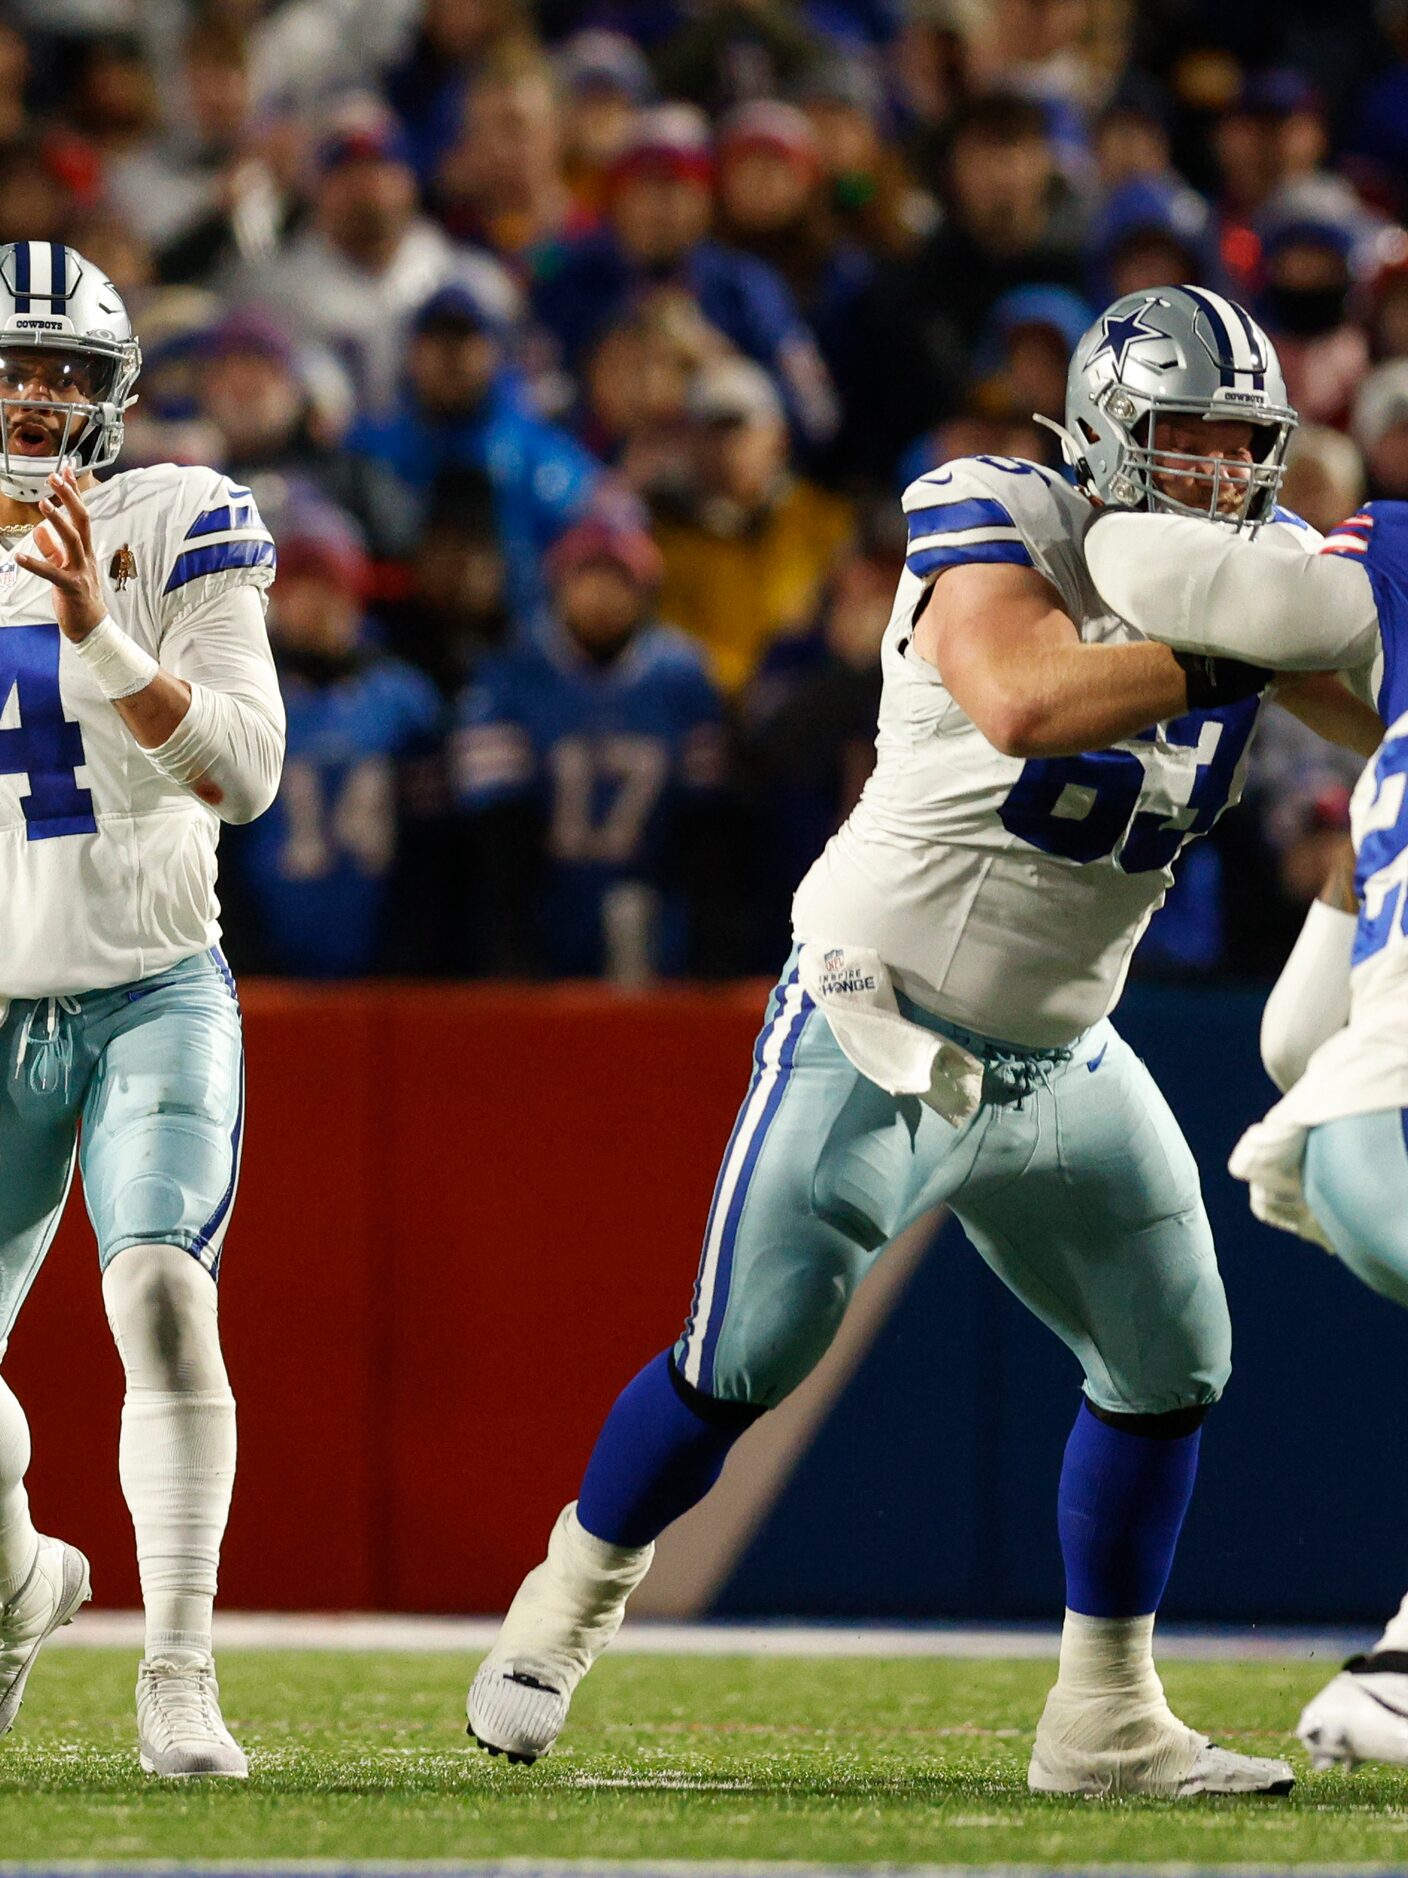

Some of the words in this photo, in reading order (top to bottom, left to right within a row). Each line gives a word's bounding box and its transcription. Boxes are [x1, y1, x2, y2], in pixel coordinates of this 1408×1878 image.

[16, 320, 63, 331] COWBOYS
[282, 752, 396, 880] 14
[546, 732, 672, 860] 17
